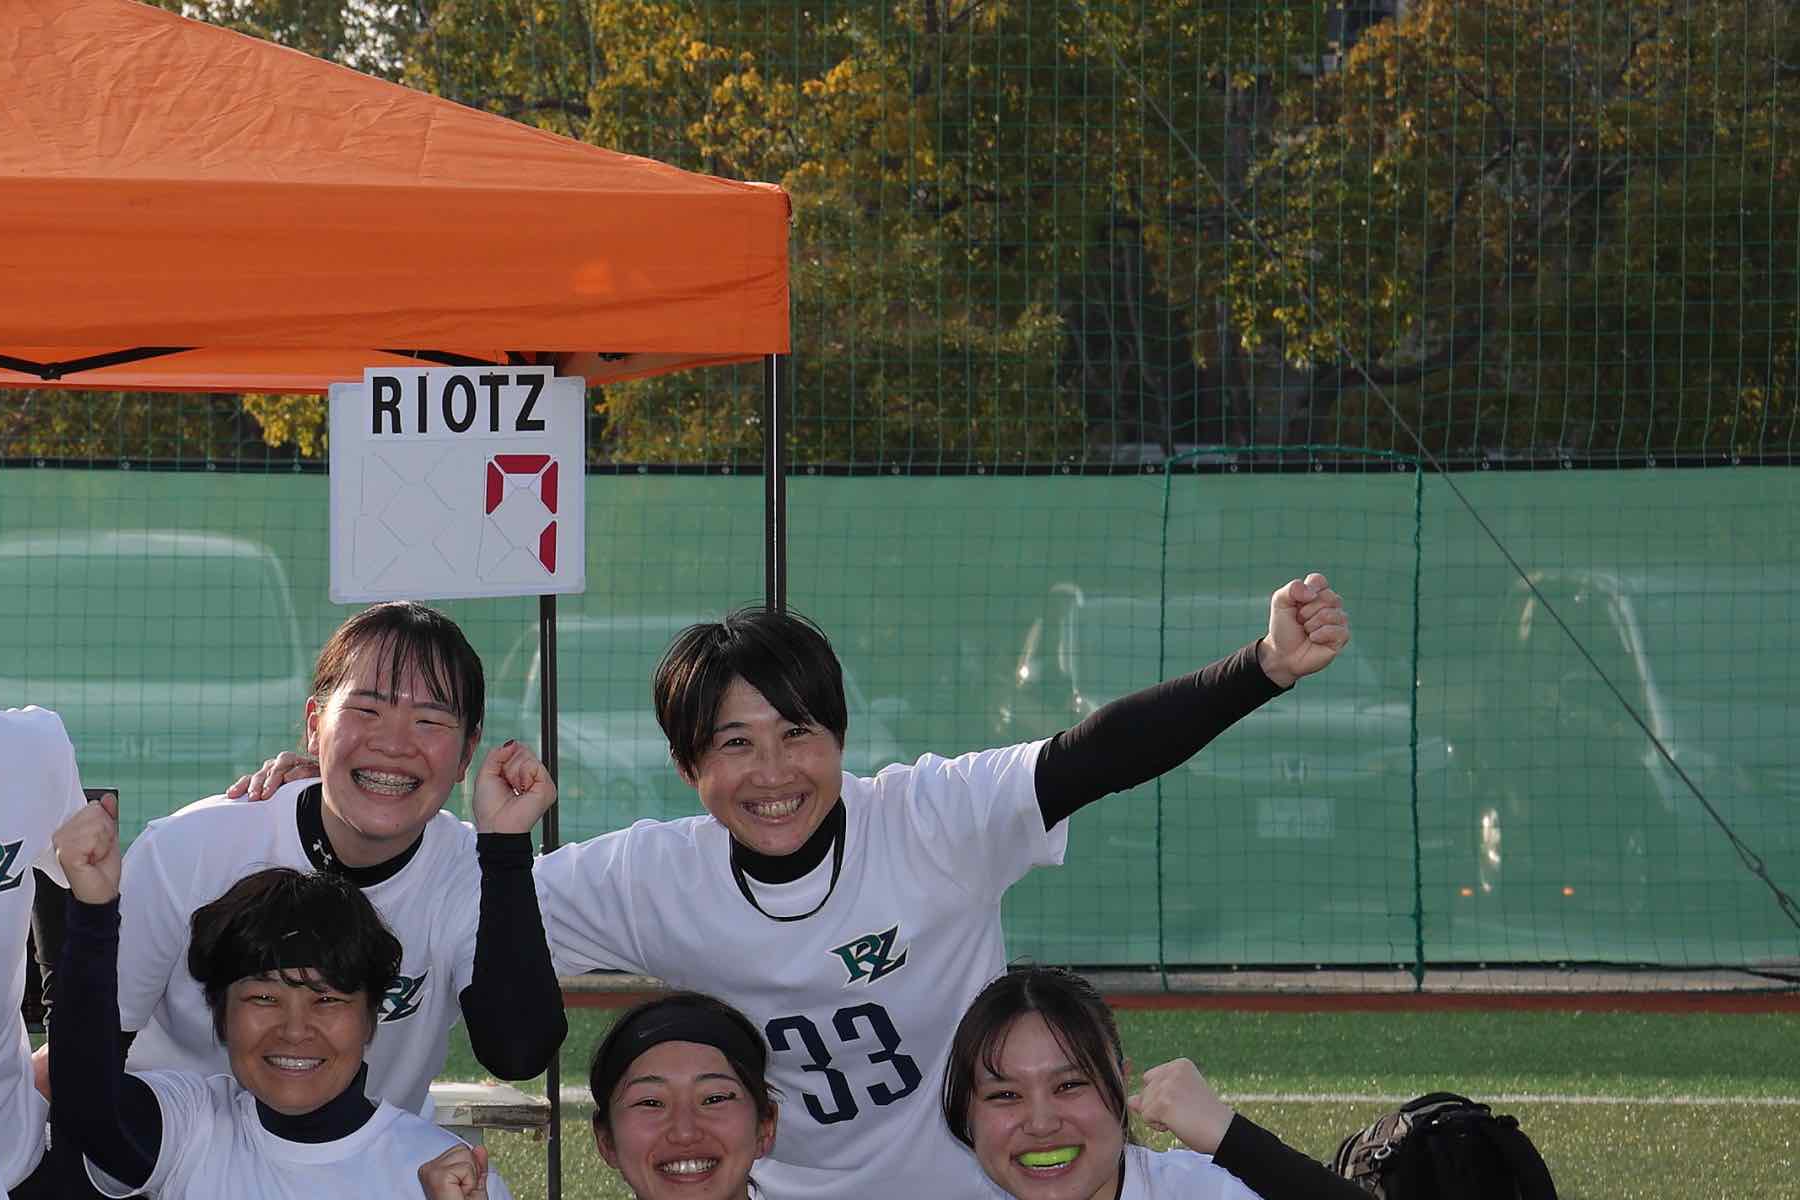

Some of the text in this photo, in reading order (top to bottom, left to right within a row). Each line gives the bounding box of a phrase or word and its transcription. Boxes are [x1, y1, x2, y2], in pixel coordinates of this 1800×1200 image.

[372, 374, 545, 434] RIOTZ
[485, 454, 558, 575] 7
[764, 1002, 923, 1125] 33
